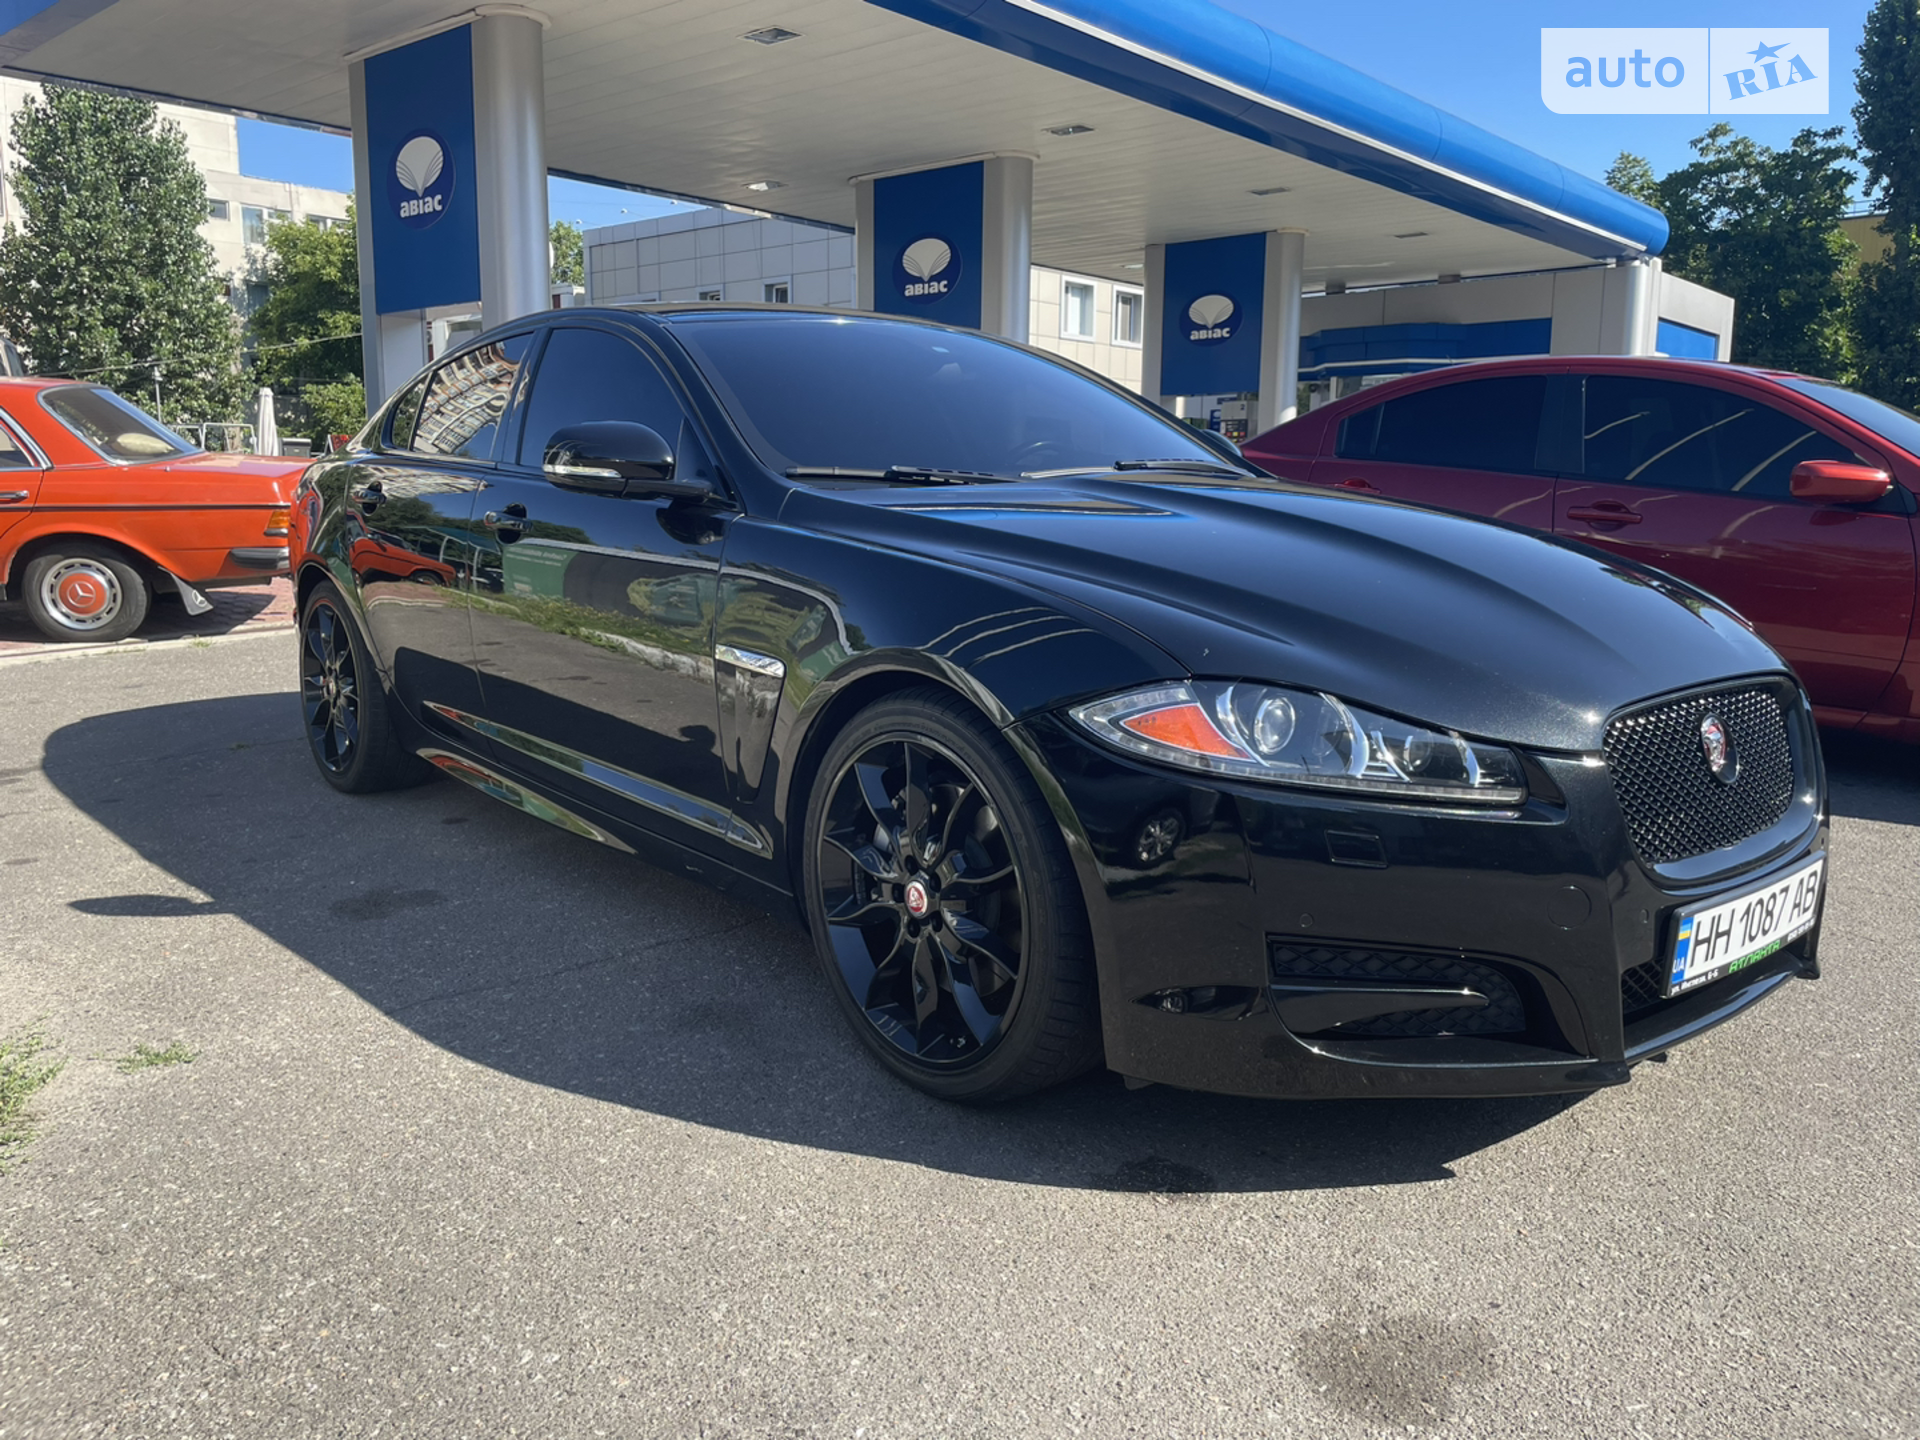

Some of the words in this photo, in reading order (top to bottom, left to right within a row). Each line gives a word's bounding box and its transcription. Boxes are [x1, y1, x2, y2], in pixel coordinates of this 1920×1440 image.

[1689, 908, 1735, 968] HH
[1739, 884, 1791, 947] 1087
[1788, 870, 1818, 923] AB
[1672, 957, 1685, 973] UA
